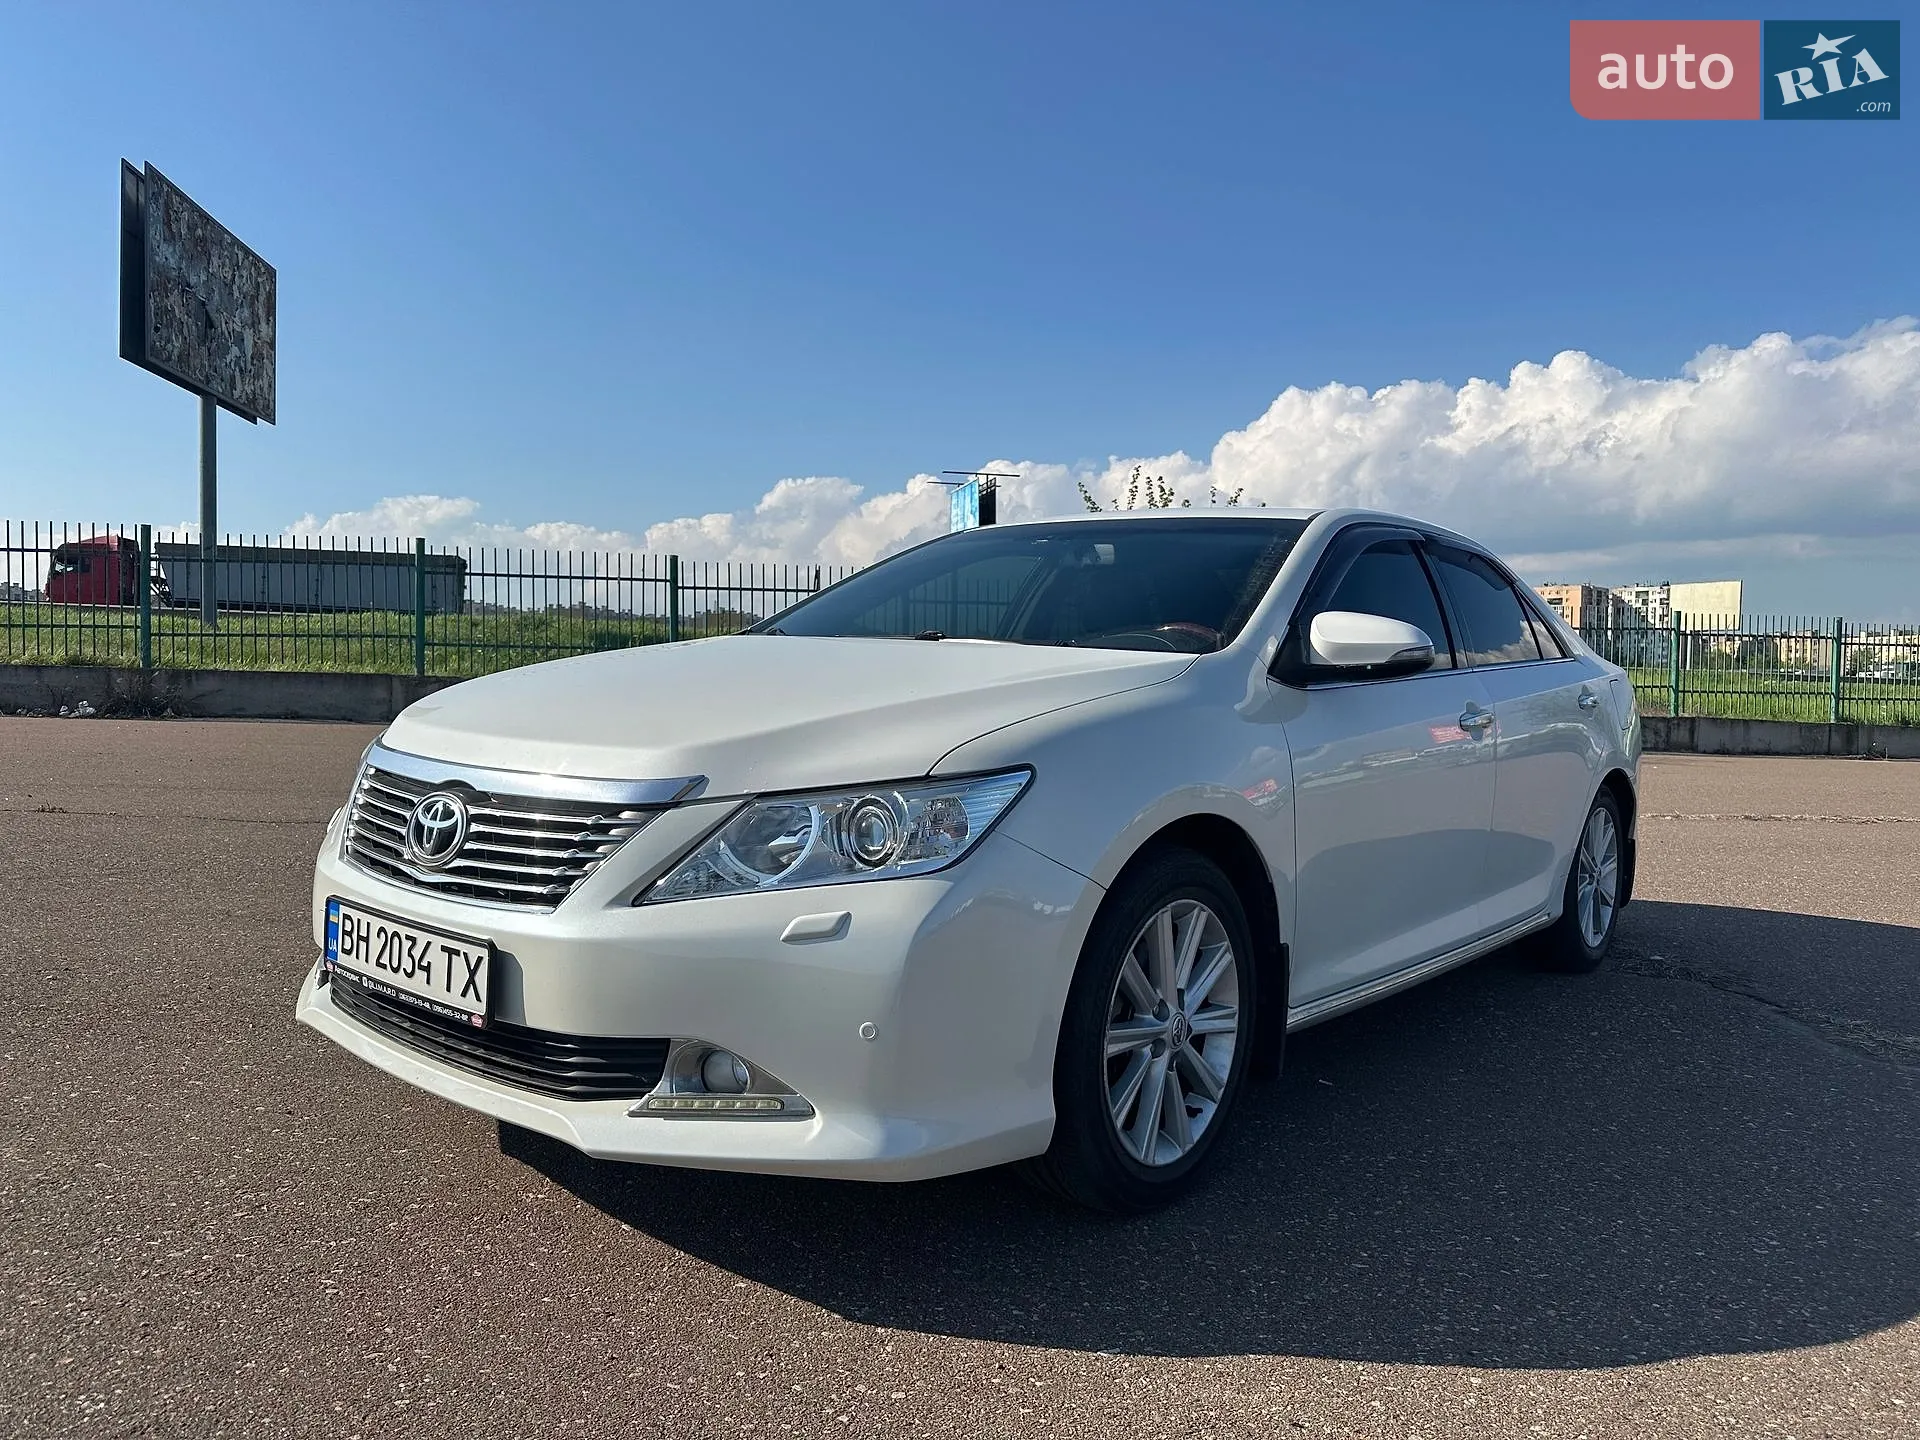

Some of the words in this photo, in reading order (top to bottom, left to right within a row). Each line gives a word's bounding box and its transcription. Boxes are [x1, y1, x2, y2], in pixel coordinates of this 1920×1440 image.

[328, 937, 338, 952] UA
[341, 913, 371, 963] BH
[376, 927, 433, 985] 2034
[440, 944, 484, 1003] TX
